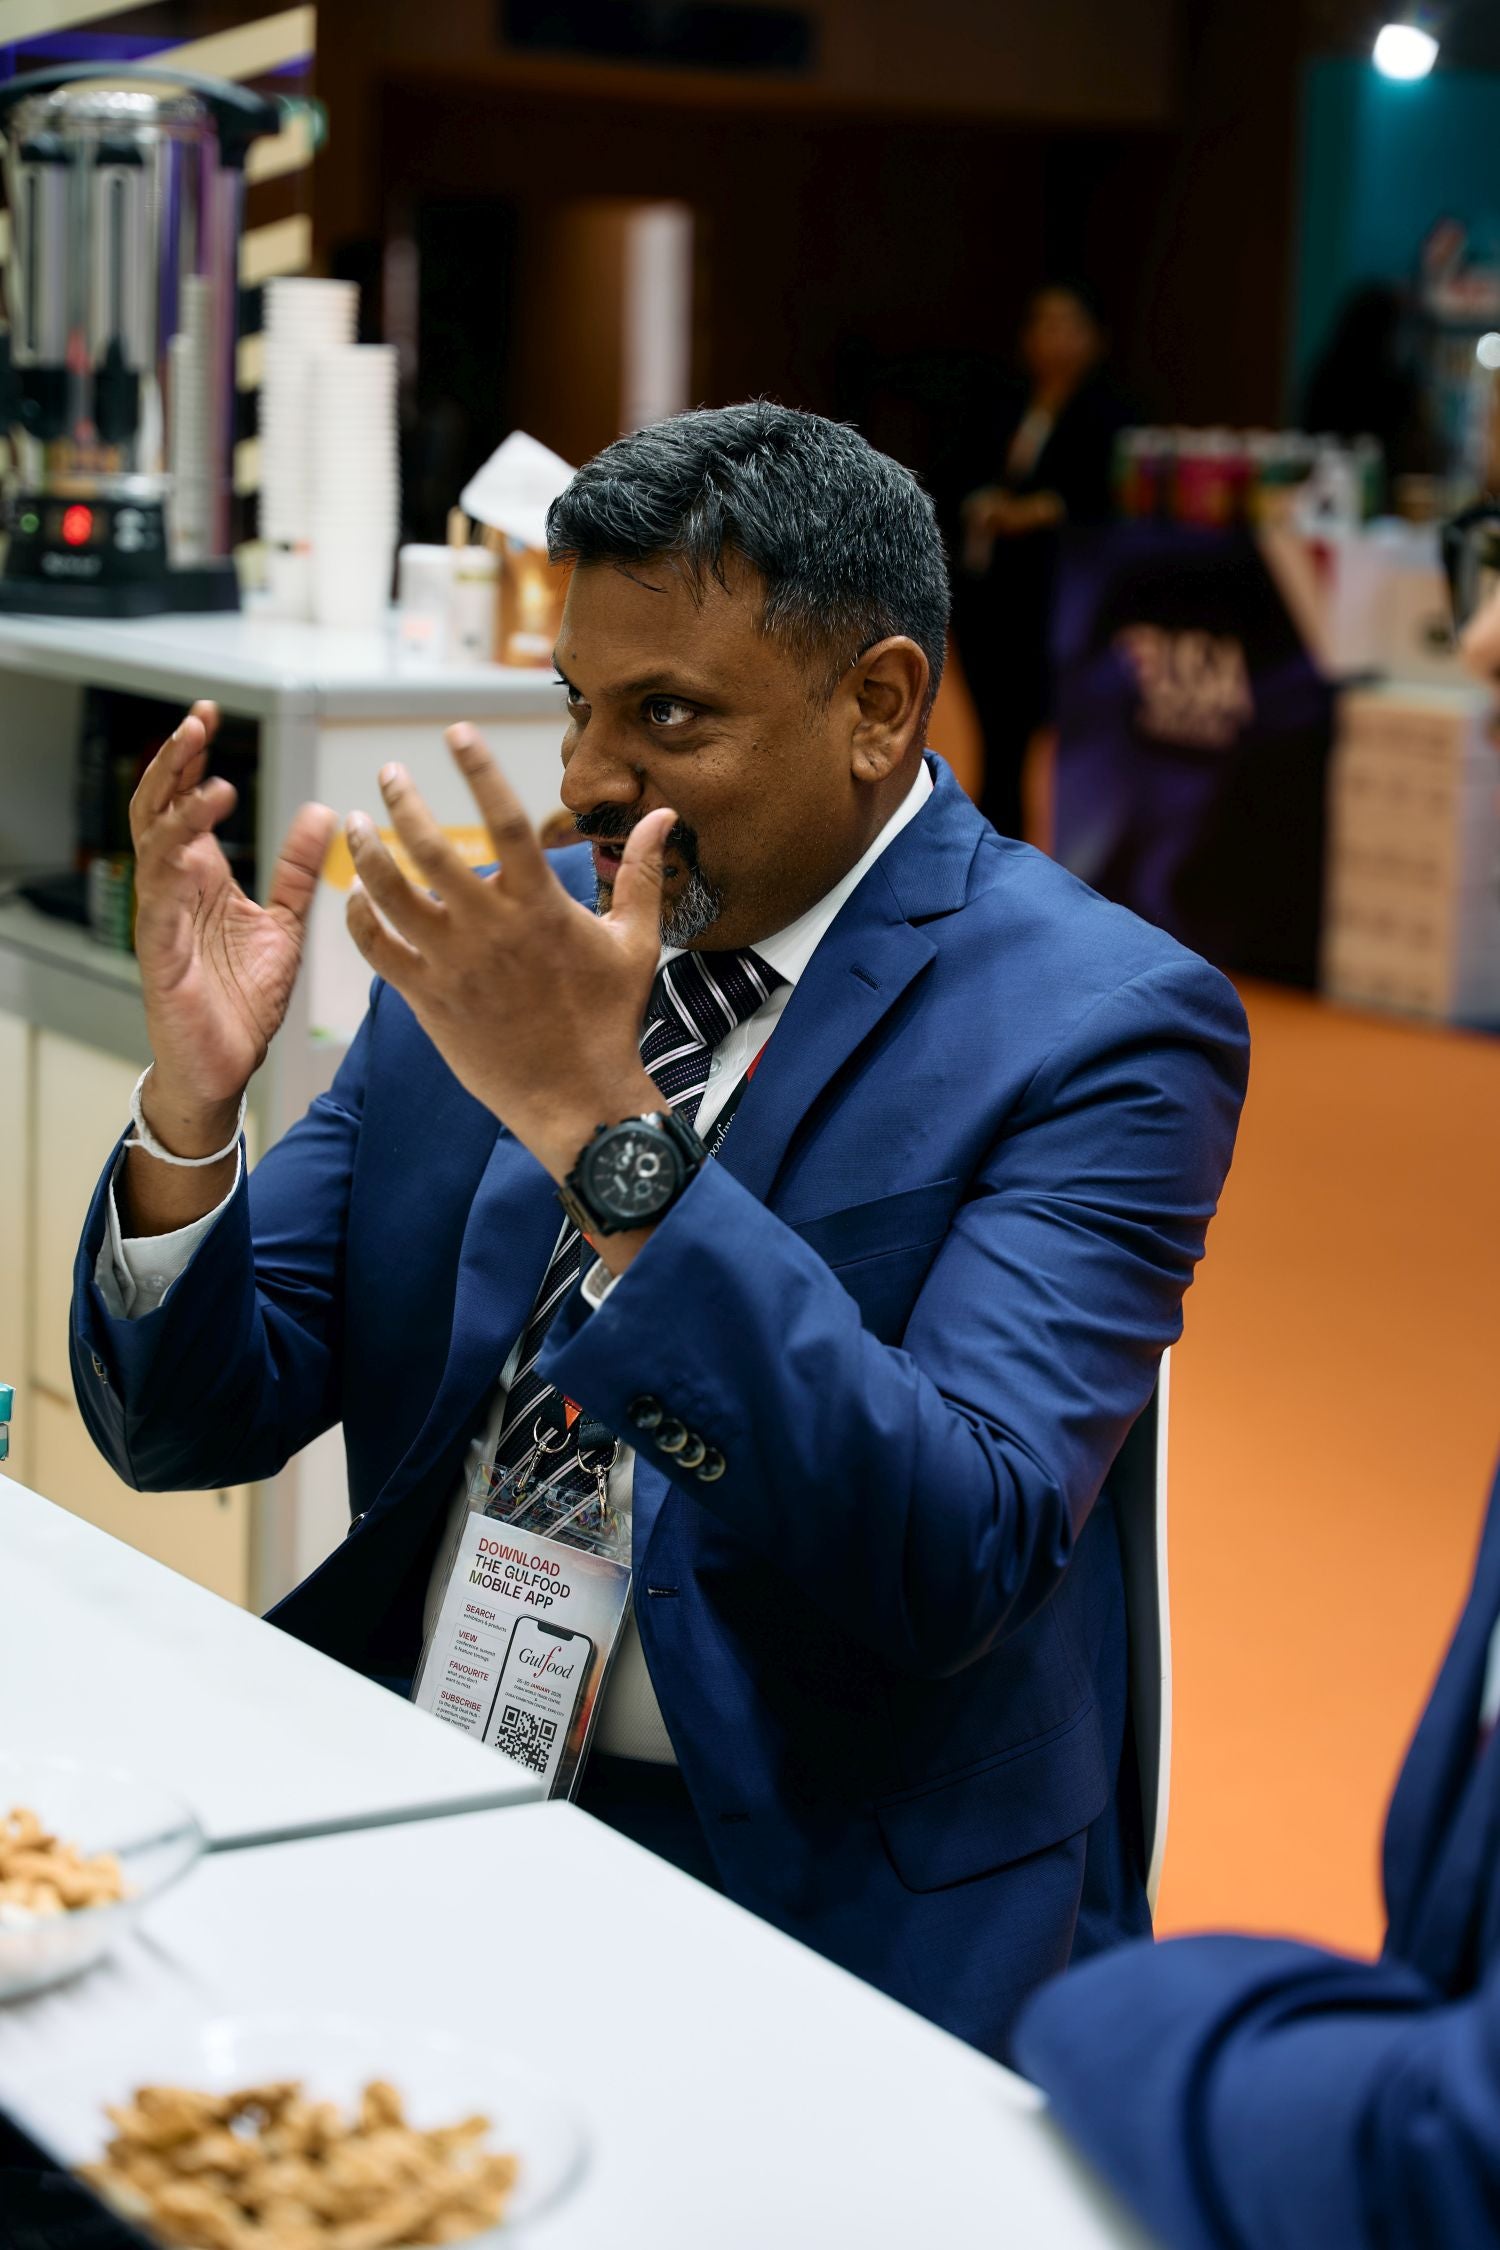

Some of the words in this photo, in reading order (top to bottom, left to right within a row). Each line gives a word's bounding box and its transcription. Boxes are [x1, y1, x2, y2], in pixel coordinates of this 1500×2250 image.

[479, 1538, 560, 1576] DOWNLOAD
[476, 1554, 502, 1574] THE
[505, 1566, 570, 1598] GULFOOD
[469, 1570, 522, 1599] MOBILE
[524, 1590, 554, 1608] APP
[466, 1604, 496, 1620] SEARCH
[464, 1613, 484, 1624] exhibitors
[488, 1622, 507, 1632] products
[459, 1629, 478, 1642] VIEW
[450, 1661, 489, 1681] FAVOURITE
[519, 1646, 574, 1679] Gulfood
[531, 1683, 550, 1694] JANUARY
[441, 1690, 482, 1712] SUBSCRIBE
[440, 1708, 458, 1718] premium
